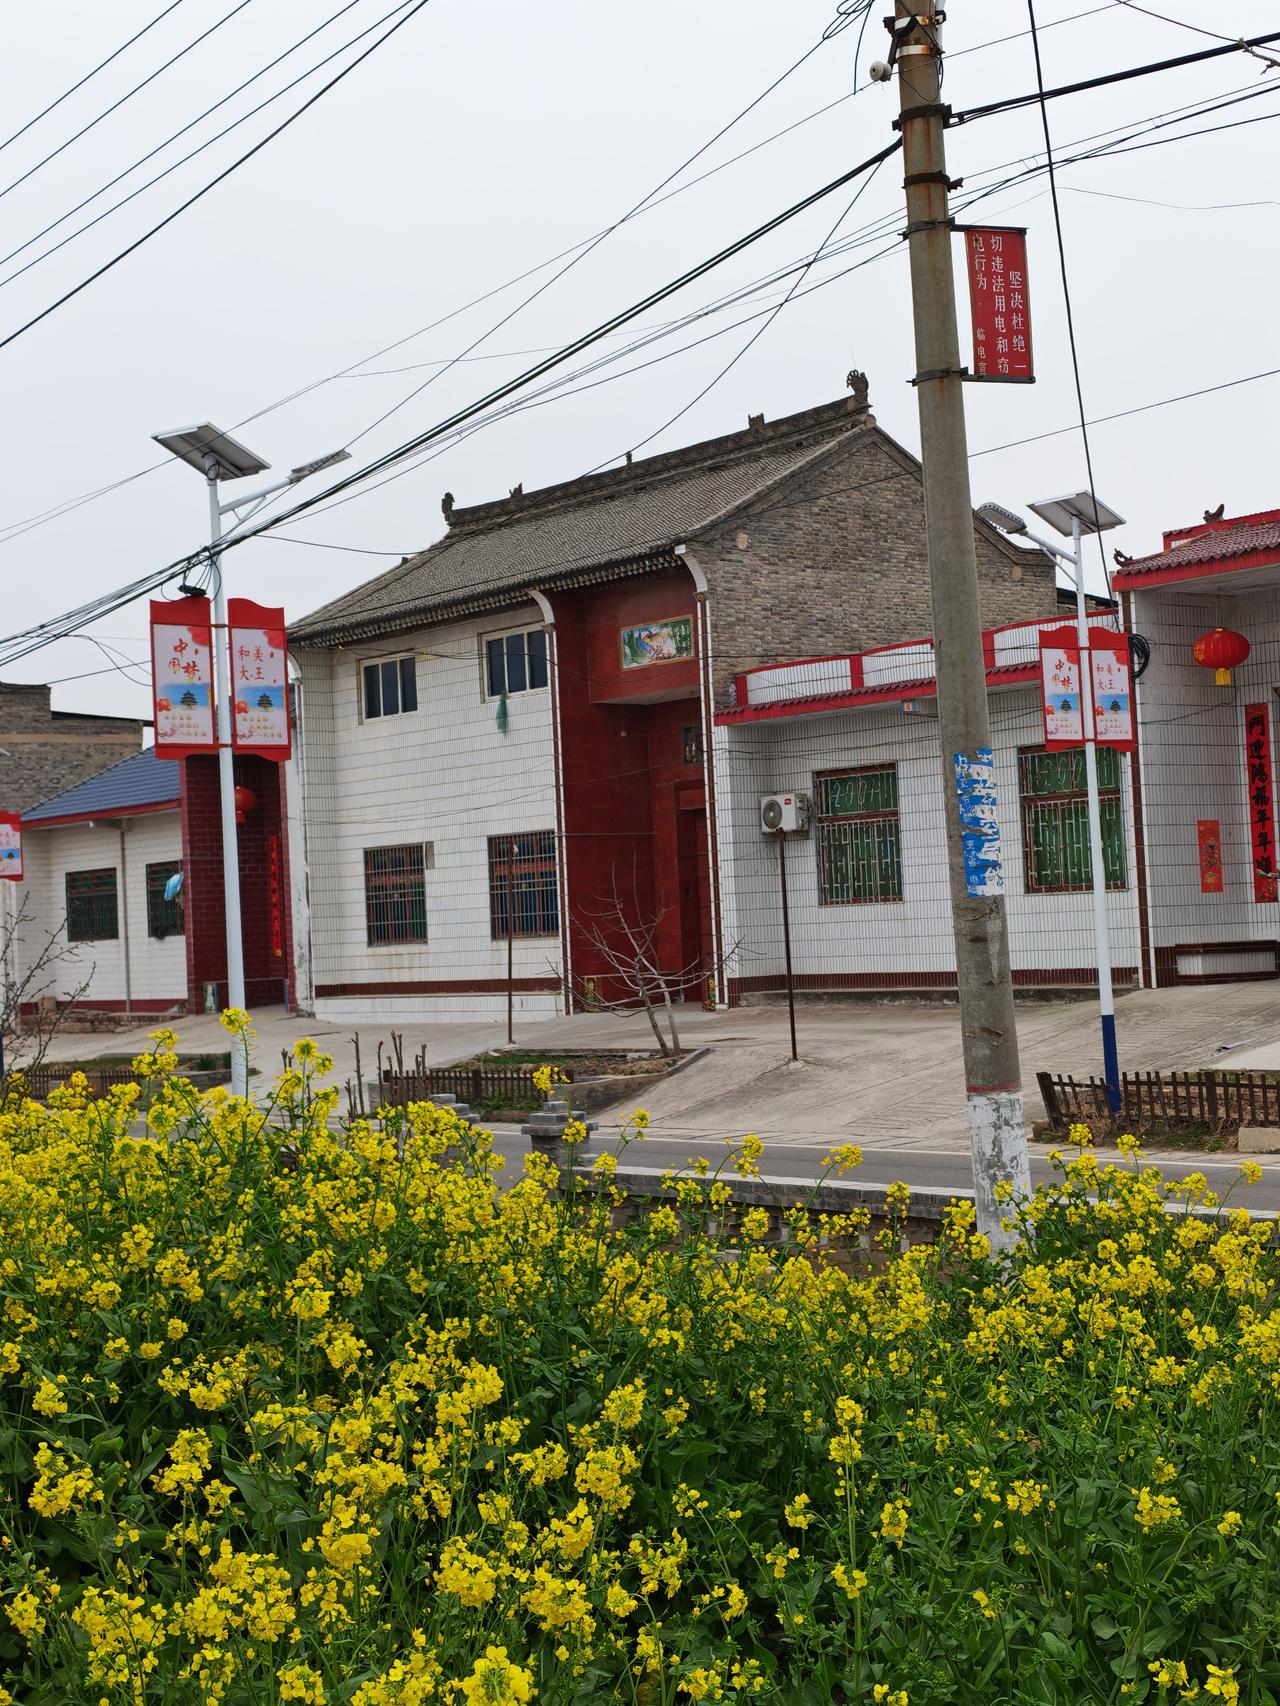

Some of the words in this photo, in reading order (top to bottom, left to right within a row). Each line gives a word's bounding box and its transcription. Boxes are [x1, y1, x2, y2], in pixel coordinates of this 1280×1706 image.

[990, 235, 1009, 375] 切违法用电和窃
[1009, 271, 1027, 369] 坚决杜绝一
